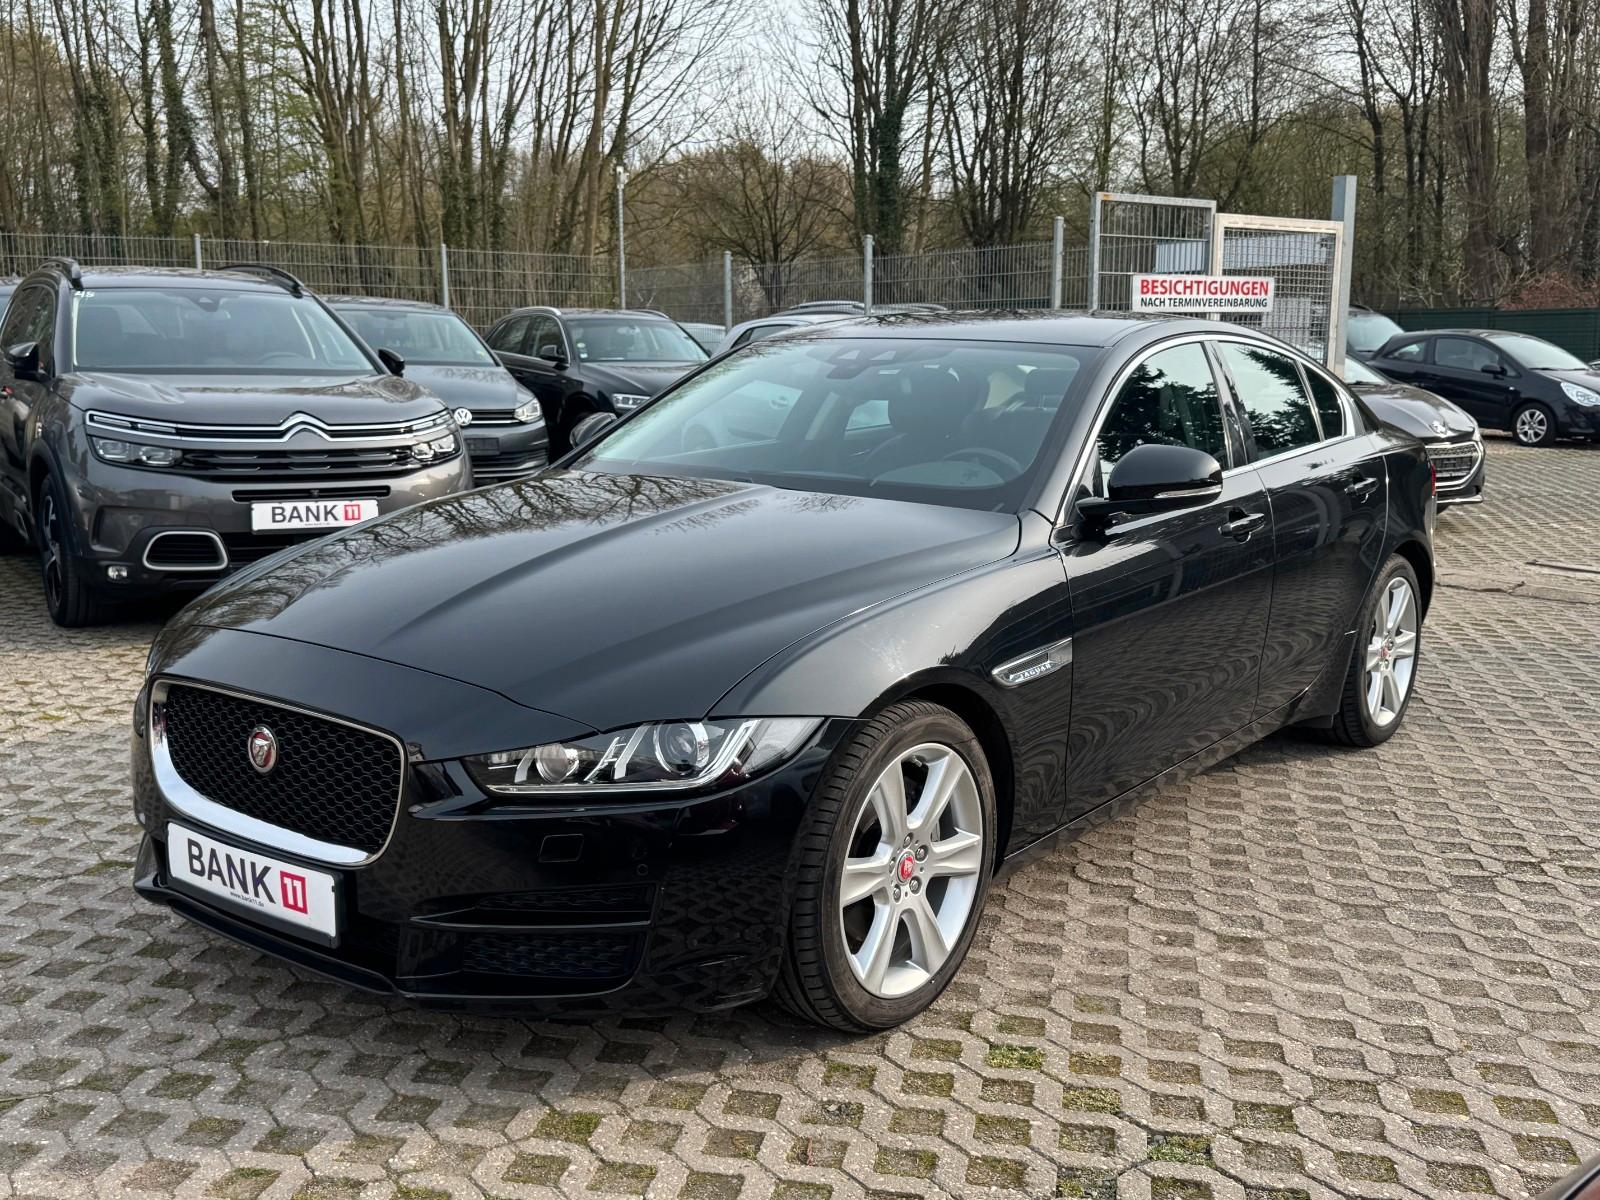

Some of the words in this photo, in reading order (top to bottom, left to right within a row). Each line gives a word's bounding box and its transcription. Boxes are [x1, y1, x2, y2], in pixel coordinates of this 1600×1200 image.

[1140, 279, 1269, 296] BESICHTIGUNGEN
[1140, 297, 1166, 308] NACH
[1167, 297, 1268, 308] TERMINVEREINBARUNG
[454, 408, 472, 426] VW
[271, 505, 339, 523] BANK
[345, 504, 360, 520] 11
[1020, 663, 1052, 679] JAGUAR
[187, 838, 276, 904] BANK
[281, 872, 306, 912] 11
